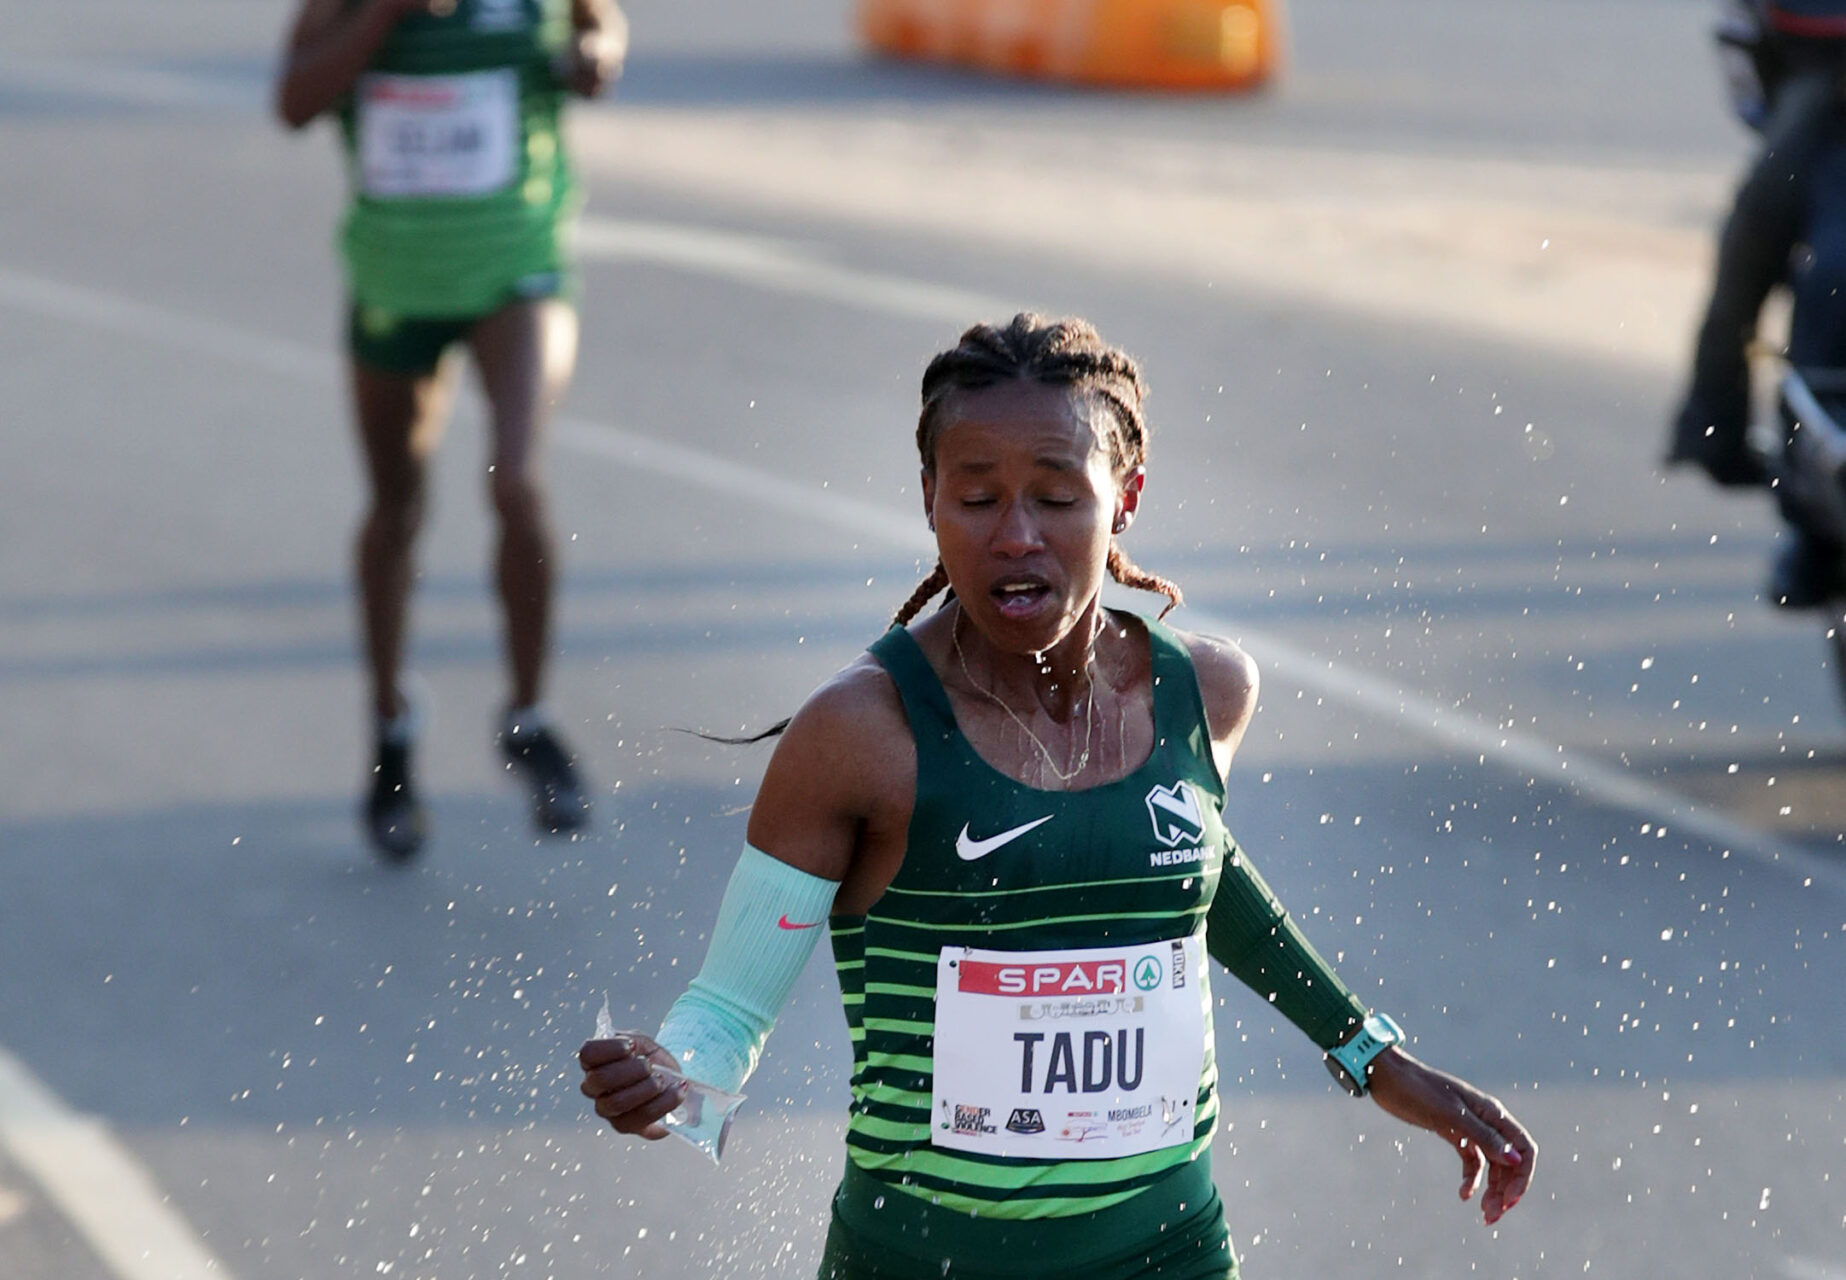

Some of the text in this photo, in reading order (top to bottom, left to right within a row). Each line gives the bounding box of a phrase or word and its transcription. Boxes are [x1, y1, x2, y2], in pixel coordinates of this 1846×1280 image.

[1150, 845, 1216, 867] NEDBANK
[998, 964, 1124, 993] SPAR
[1013, 1027, 1145, 1095] TADU
[1011, 1110, 1042, 1124] ASA
